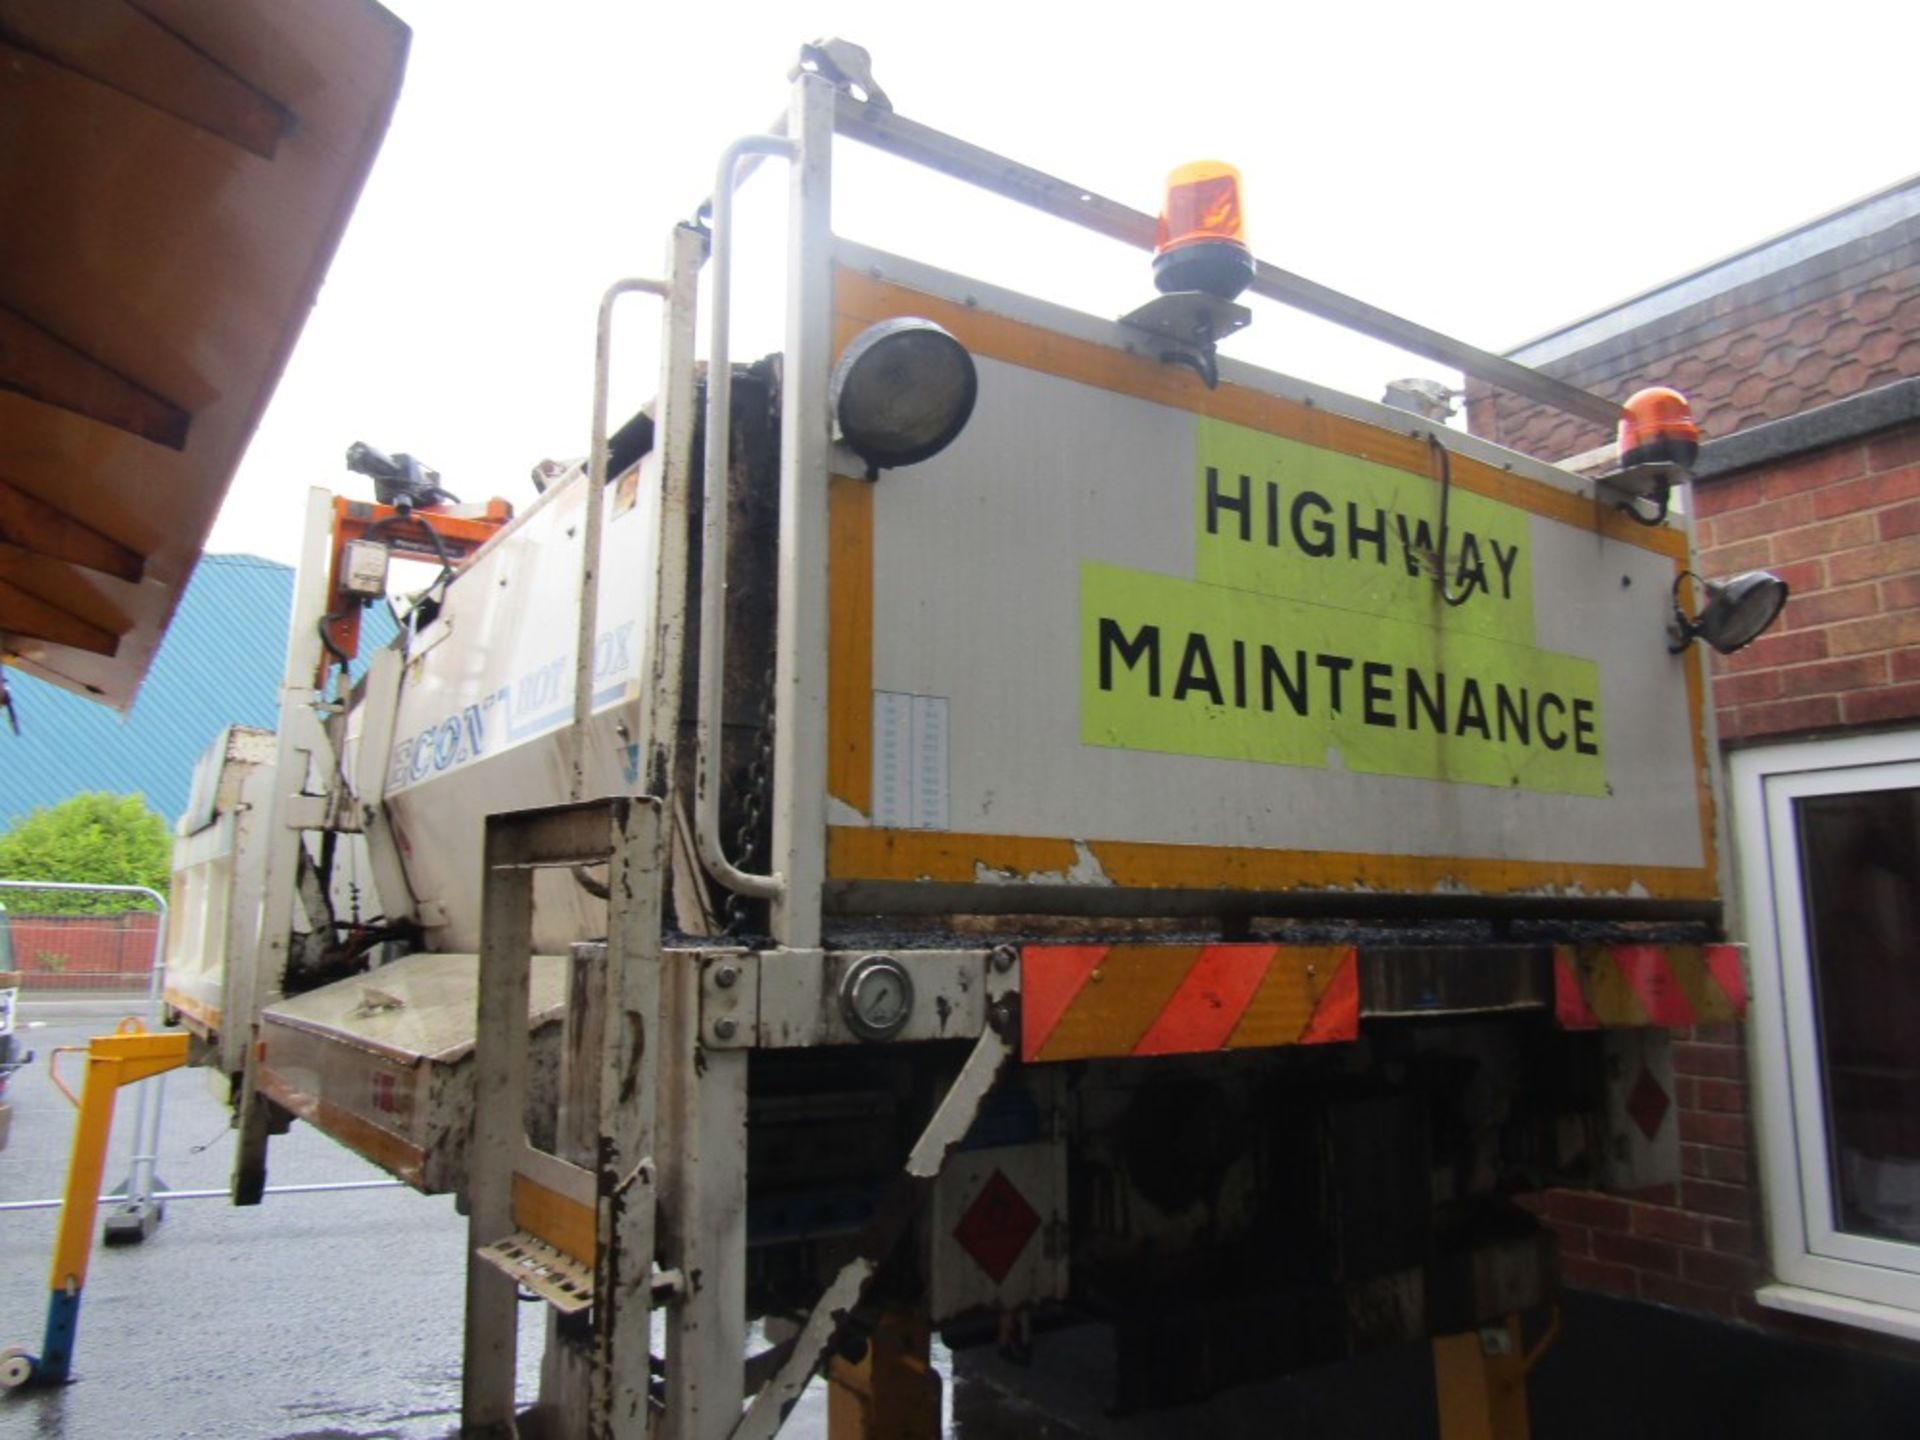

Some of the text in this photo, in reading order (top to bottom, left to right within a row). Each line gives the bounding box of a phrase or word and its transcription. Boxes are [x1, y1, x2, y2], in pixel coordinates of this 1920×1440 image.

[1206, 466, 1518, 600] HIGHWAY
[593, 619, 635, 677] OX
[1099, 617, 1599, 756] MAINTENANCE
